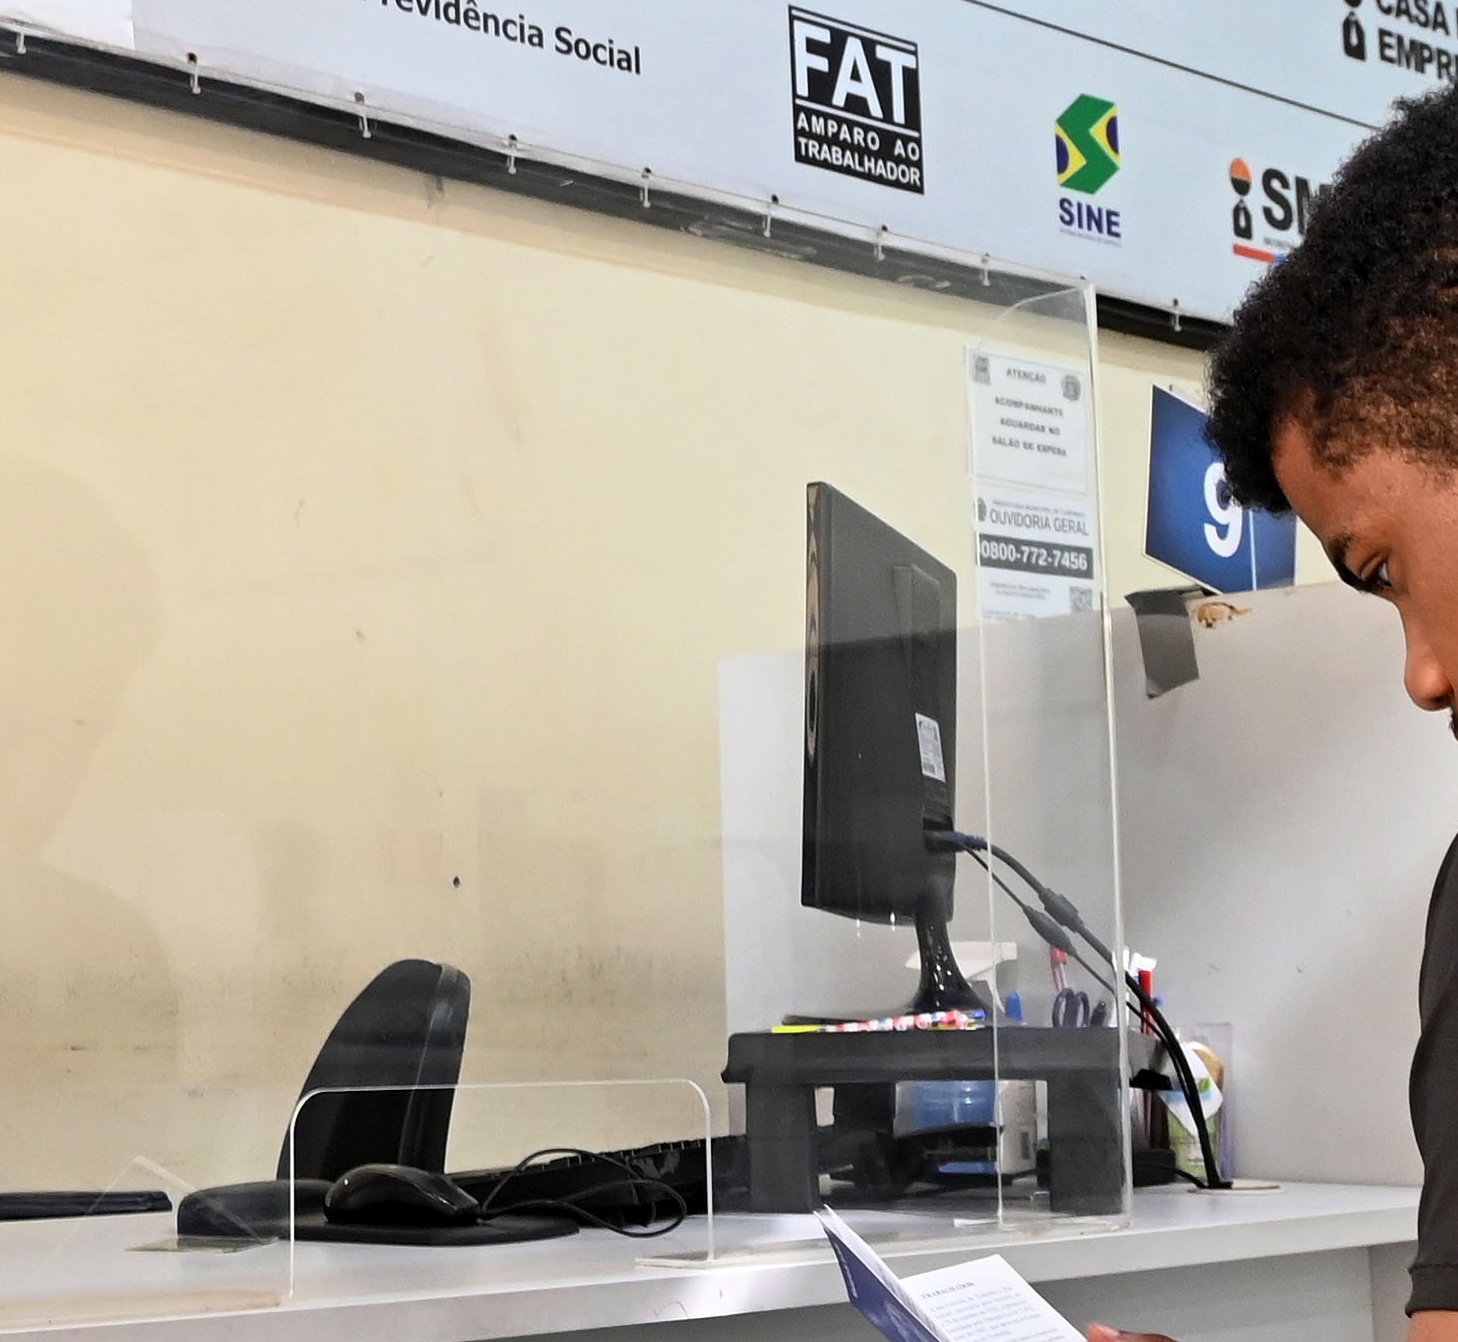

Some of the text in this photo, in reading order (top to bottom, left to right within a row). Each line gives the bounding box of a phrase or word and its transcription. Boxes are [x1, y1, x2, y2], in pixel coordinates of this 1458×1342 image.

[553, 25, 642, 76] Social
[793, 19, 917, 126] FAT
[796, 110, 921, 162] AMPARO AO
[797, 136, 922, 188] TRABALHADOR
[1059, 197, 1122, 239] SINE
[989, 508, 1052, 531] OUVIDORIA
[1054, 517, 1089, 536] GERAL
[1203, 460, 1243, 558] 9
[980, 539, 1089, 571] 0800-772-7456
